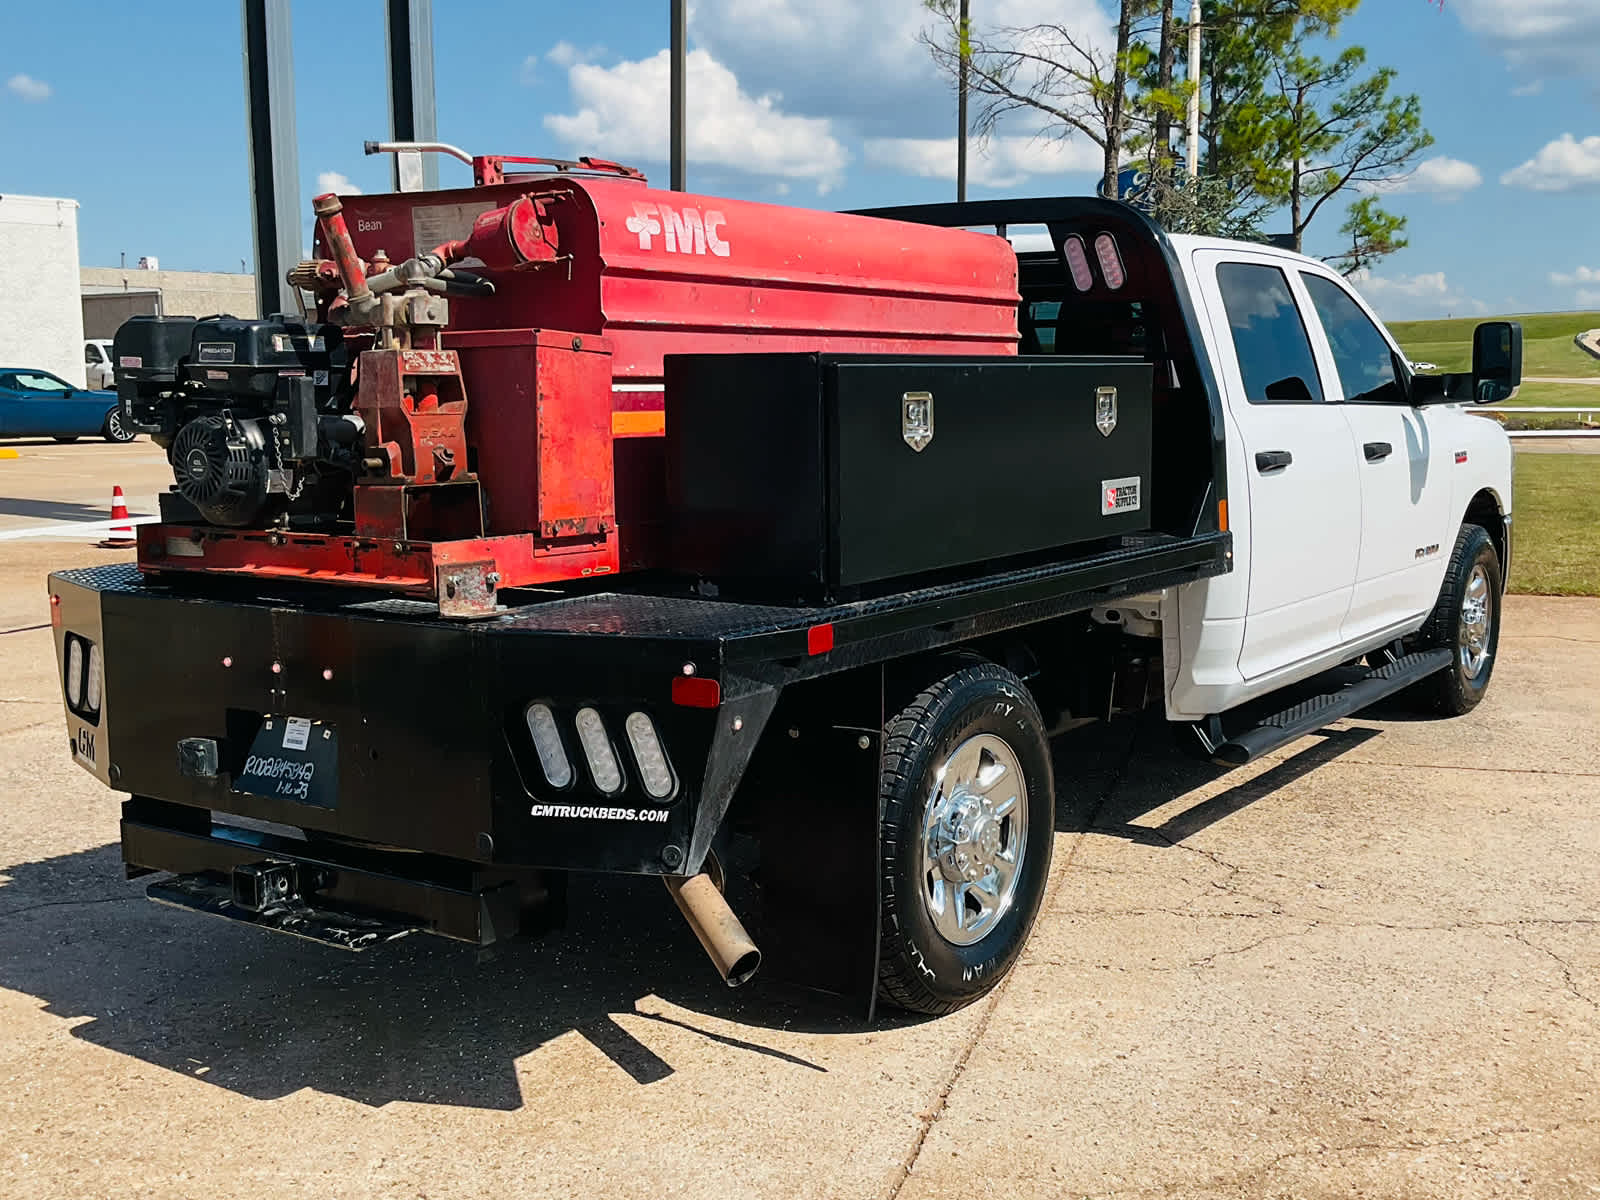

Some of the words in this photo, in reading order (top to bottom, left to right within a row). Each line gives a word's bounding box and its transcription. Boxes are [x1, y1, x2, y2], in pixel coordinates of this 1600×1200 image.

[357, 218, 383, 232] Bean
[625, 200, 731, 257] FMC
[201, 346, 233, 355] PREDATOR
[1115, 485, 1137, 497] TRACTOR
[1115, 496, 1132, 508] SUPPLY
[530, 804, 669, 823] CMTRUCKBEDS.COM
